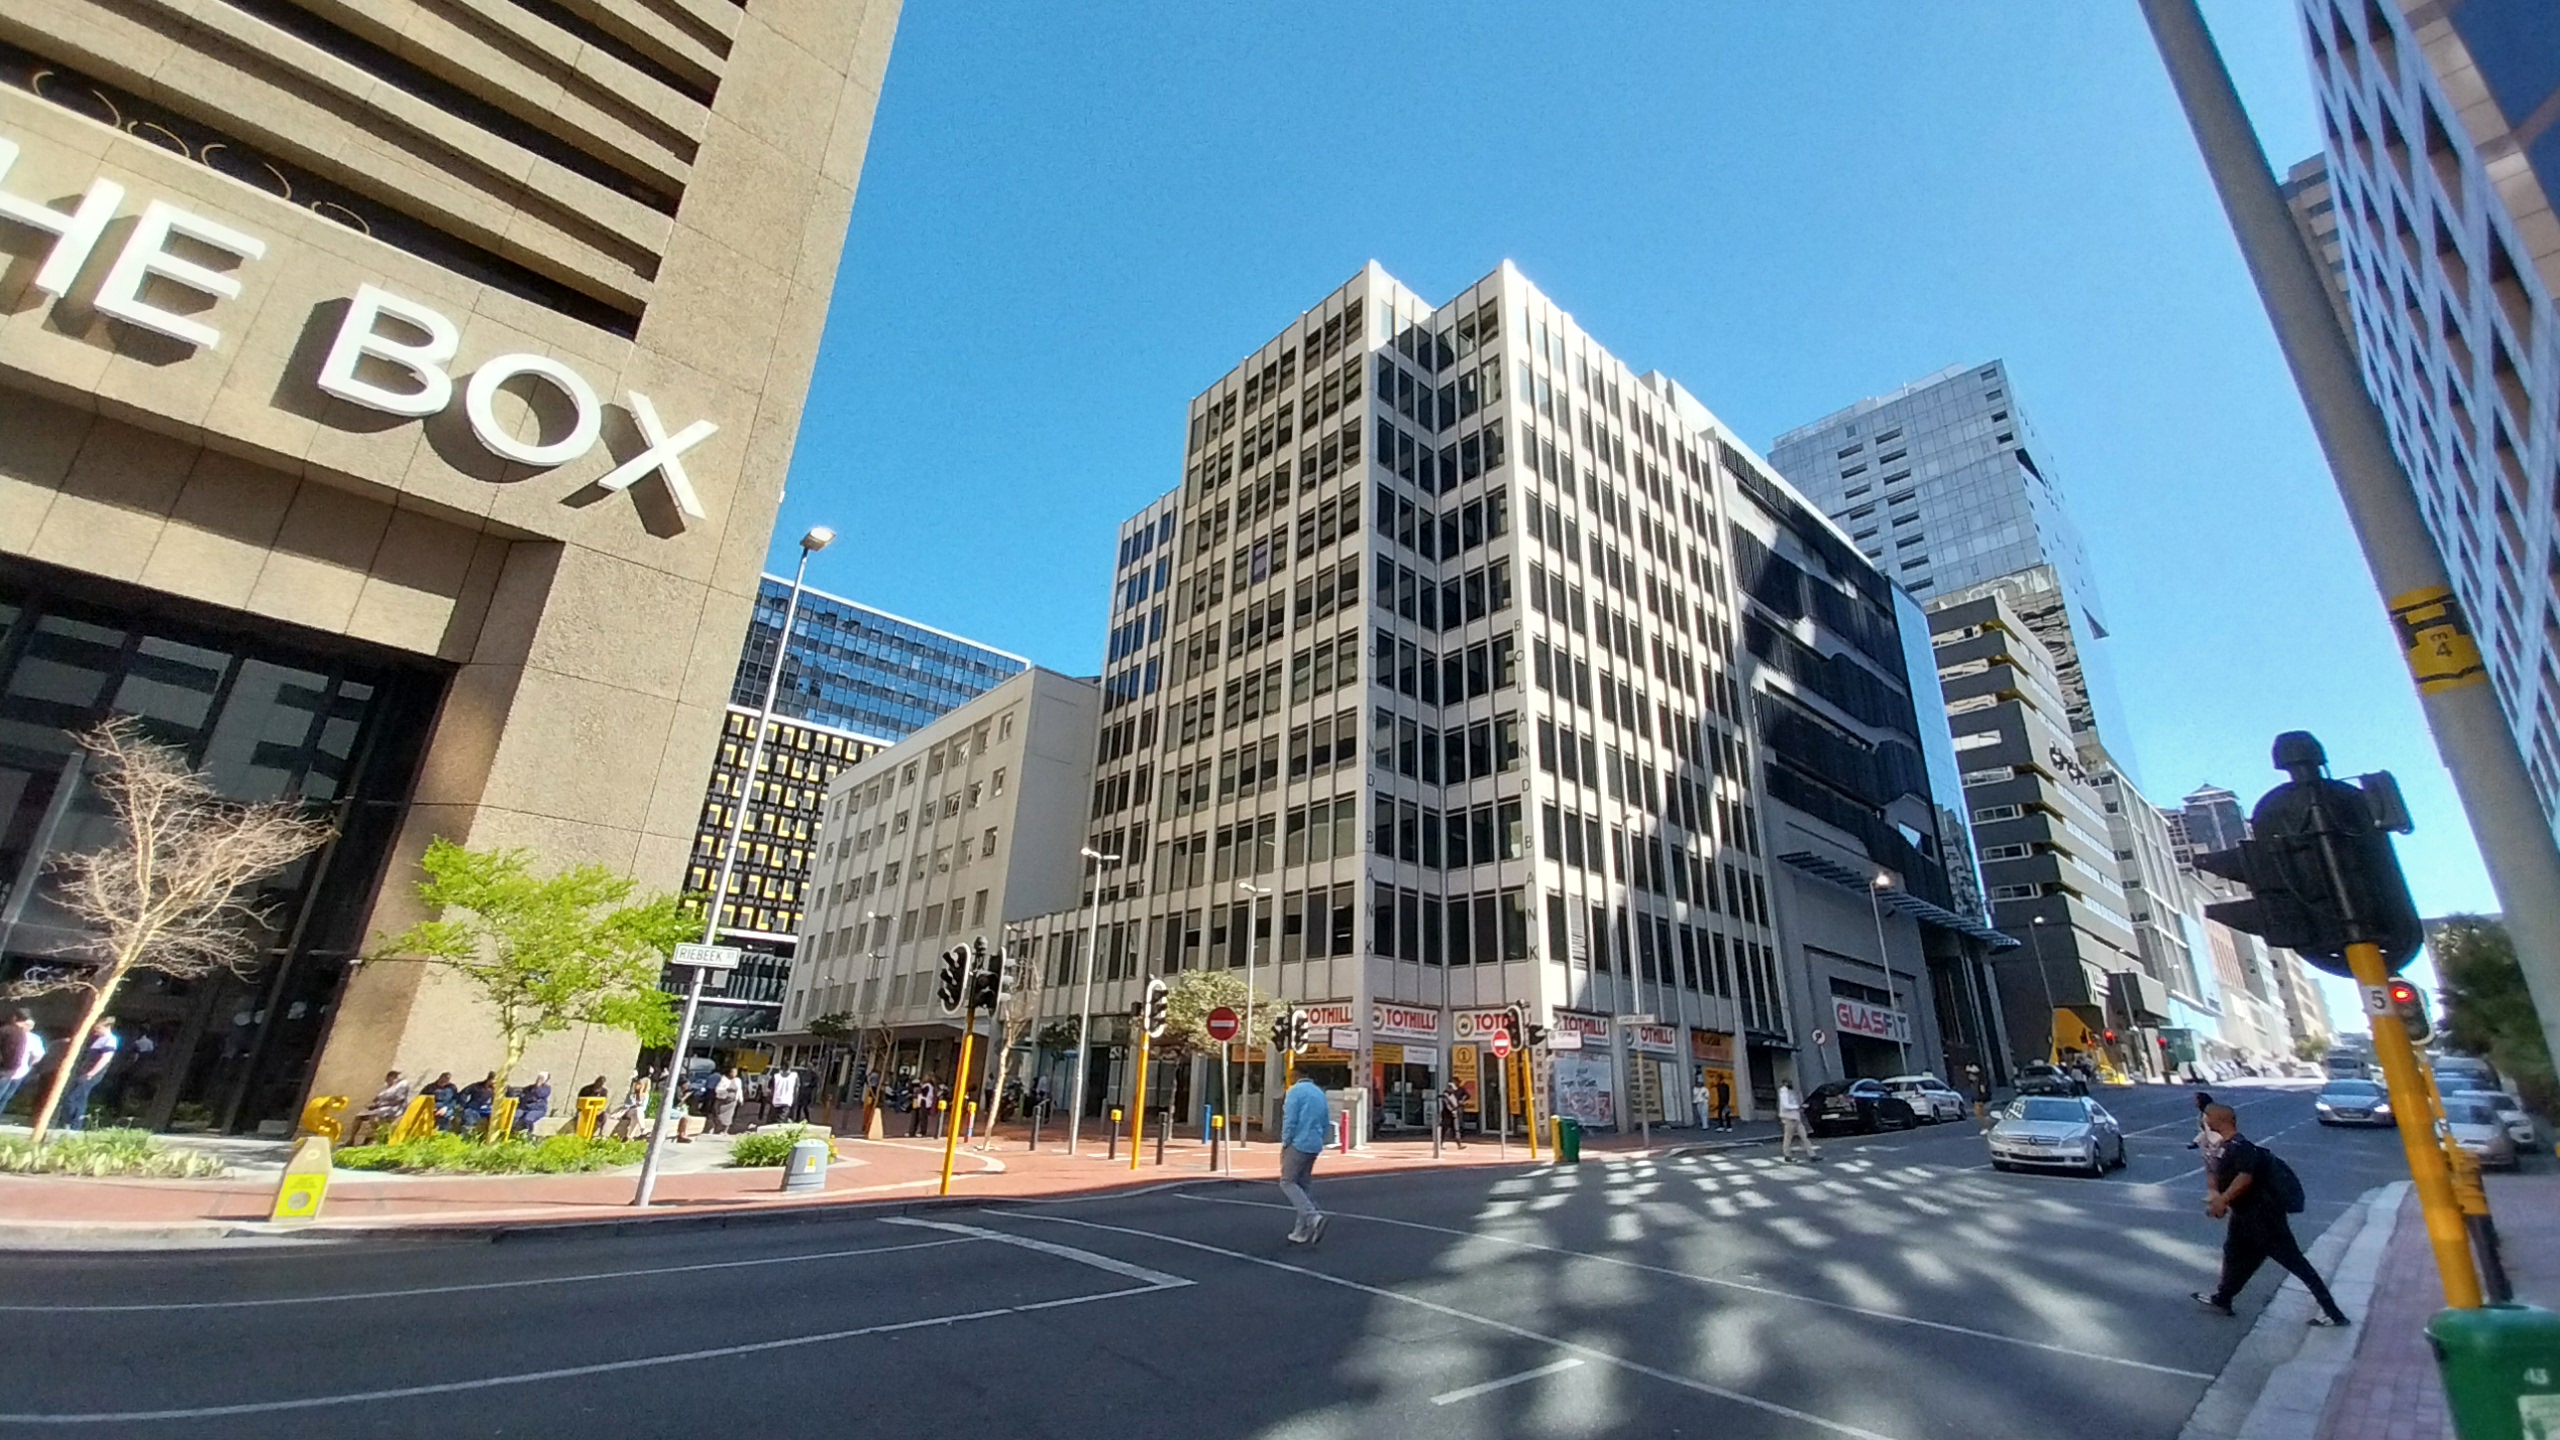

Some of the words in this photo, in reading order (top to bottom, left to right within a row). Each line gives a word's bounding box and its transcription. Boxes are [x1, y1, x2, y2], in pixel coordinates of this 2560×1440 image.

[317, 283, 721, 521] BOX
[679, 947, 722, 962] RIEBEEK
[2371, 991, 2385, 1009] 5
[1305, 1006, 1353, 1025] OTHILL
[1386, 1008, 1436, 1030] TOTHILLS
[1562, 1015, 1606, 1036] TOTHILLS
[1837, 1003, 1907, 1039] GLASFIT
[1640, 1026, 1673, 1045] OTHILLS
[1535, 1048, 1546, 1134] CHEMIST
